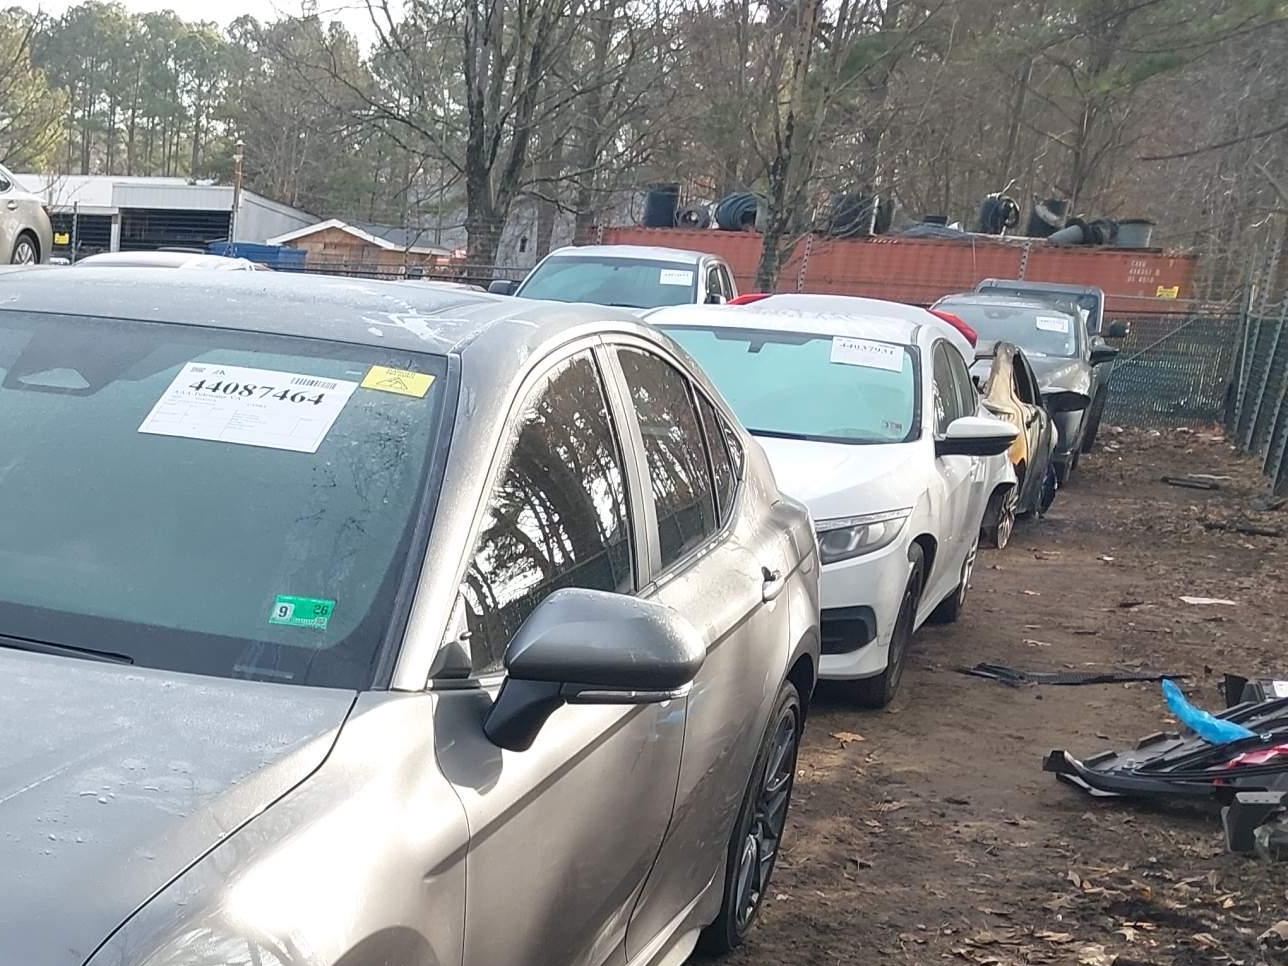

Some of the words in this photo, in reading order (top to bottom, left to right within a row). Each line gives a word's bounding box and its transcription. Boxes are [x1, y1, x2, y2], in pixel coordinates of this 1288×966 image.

[189, 379, 324, 405] 44087464
[278, 605, 289, 618] 9
[313, 604, 329, 616] 26
